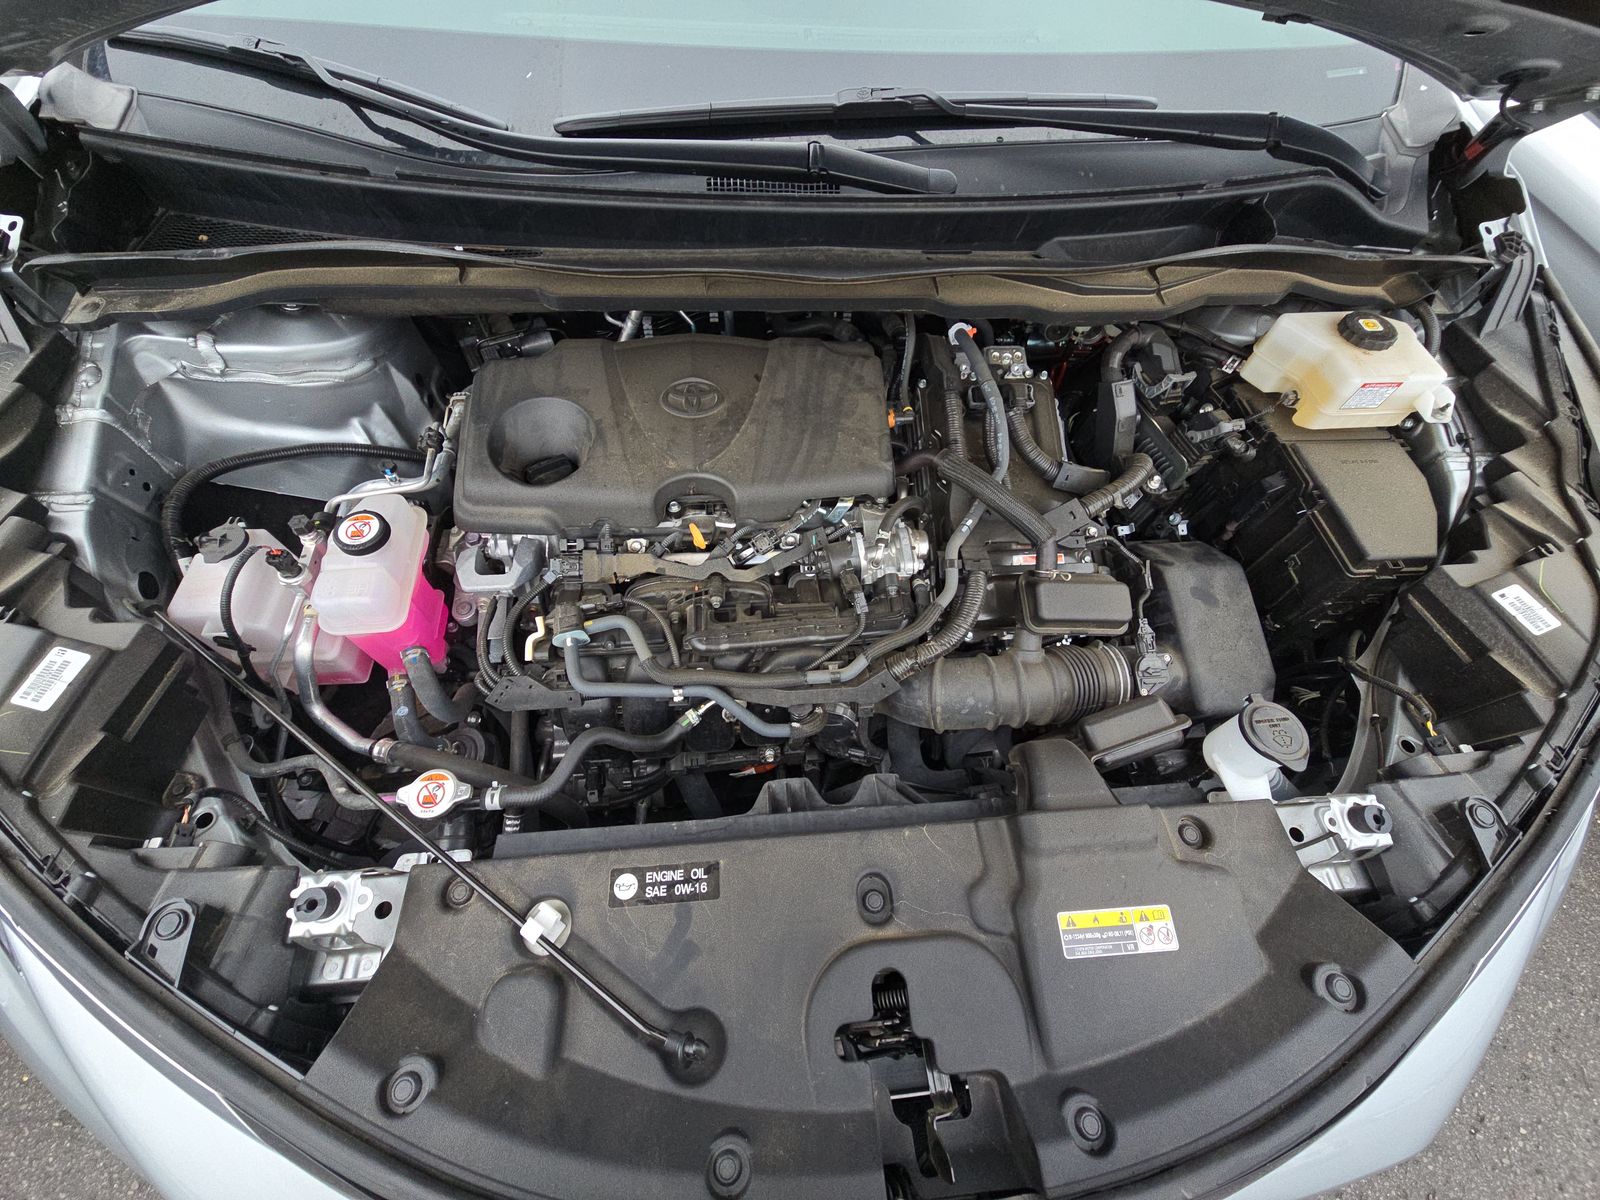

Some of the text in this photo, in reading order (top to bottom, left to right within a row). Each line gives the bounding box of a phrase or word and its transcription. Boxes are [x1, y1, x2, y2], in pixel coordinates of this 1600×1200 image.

[645, 868, 708, 883] ENGINE OIL
[645, 882, 708, 898] SAE 0W-16
